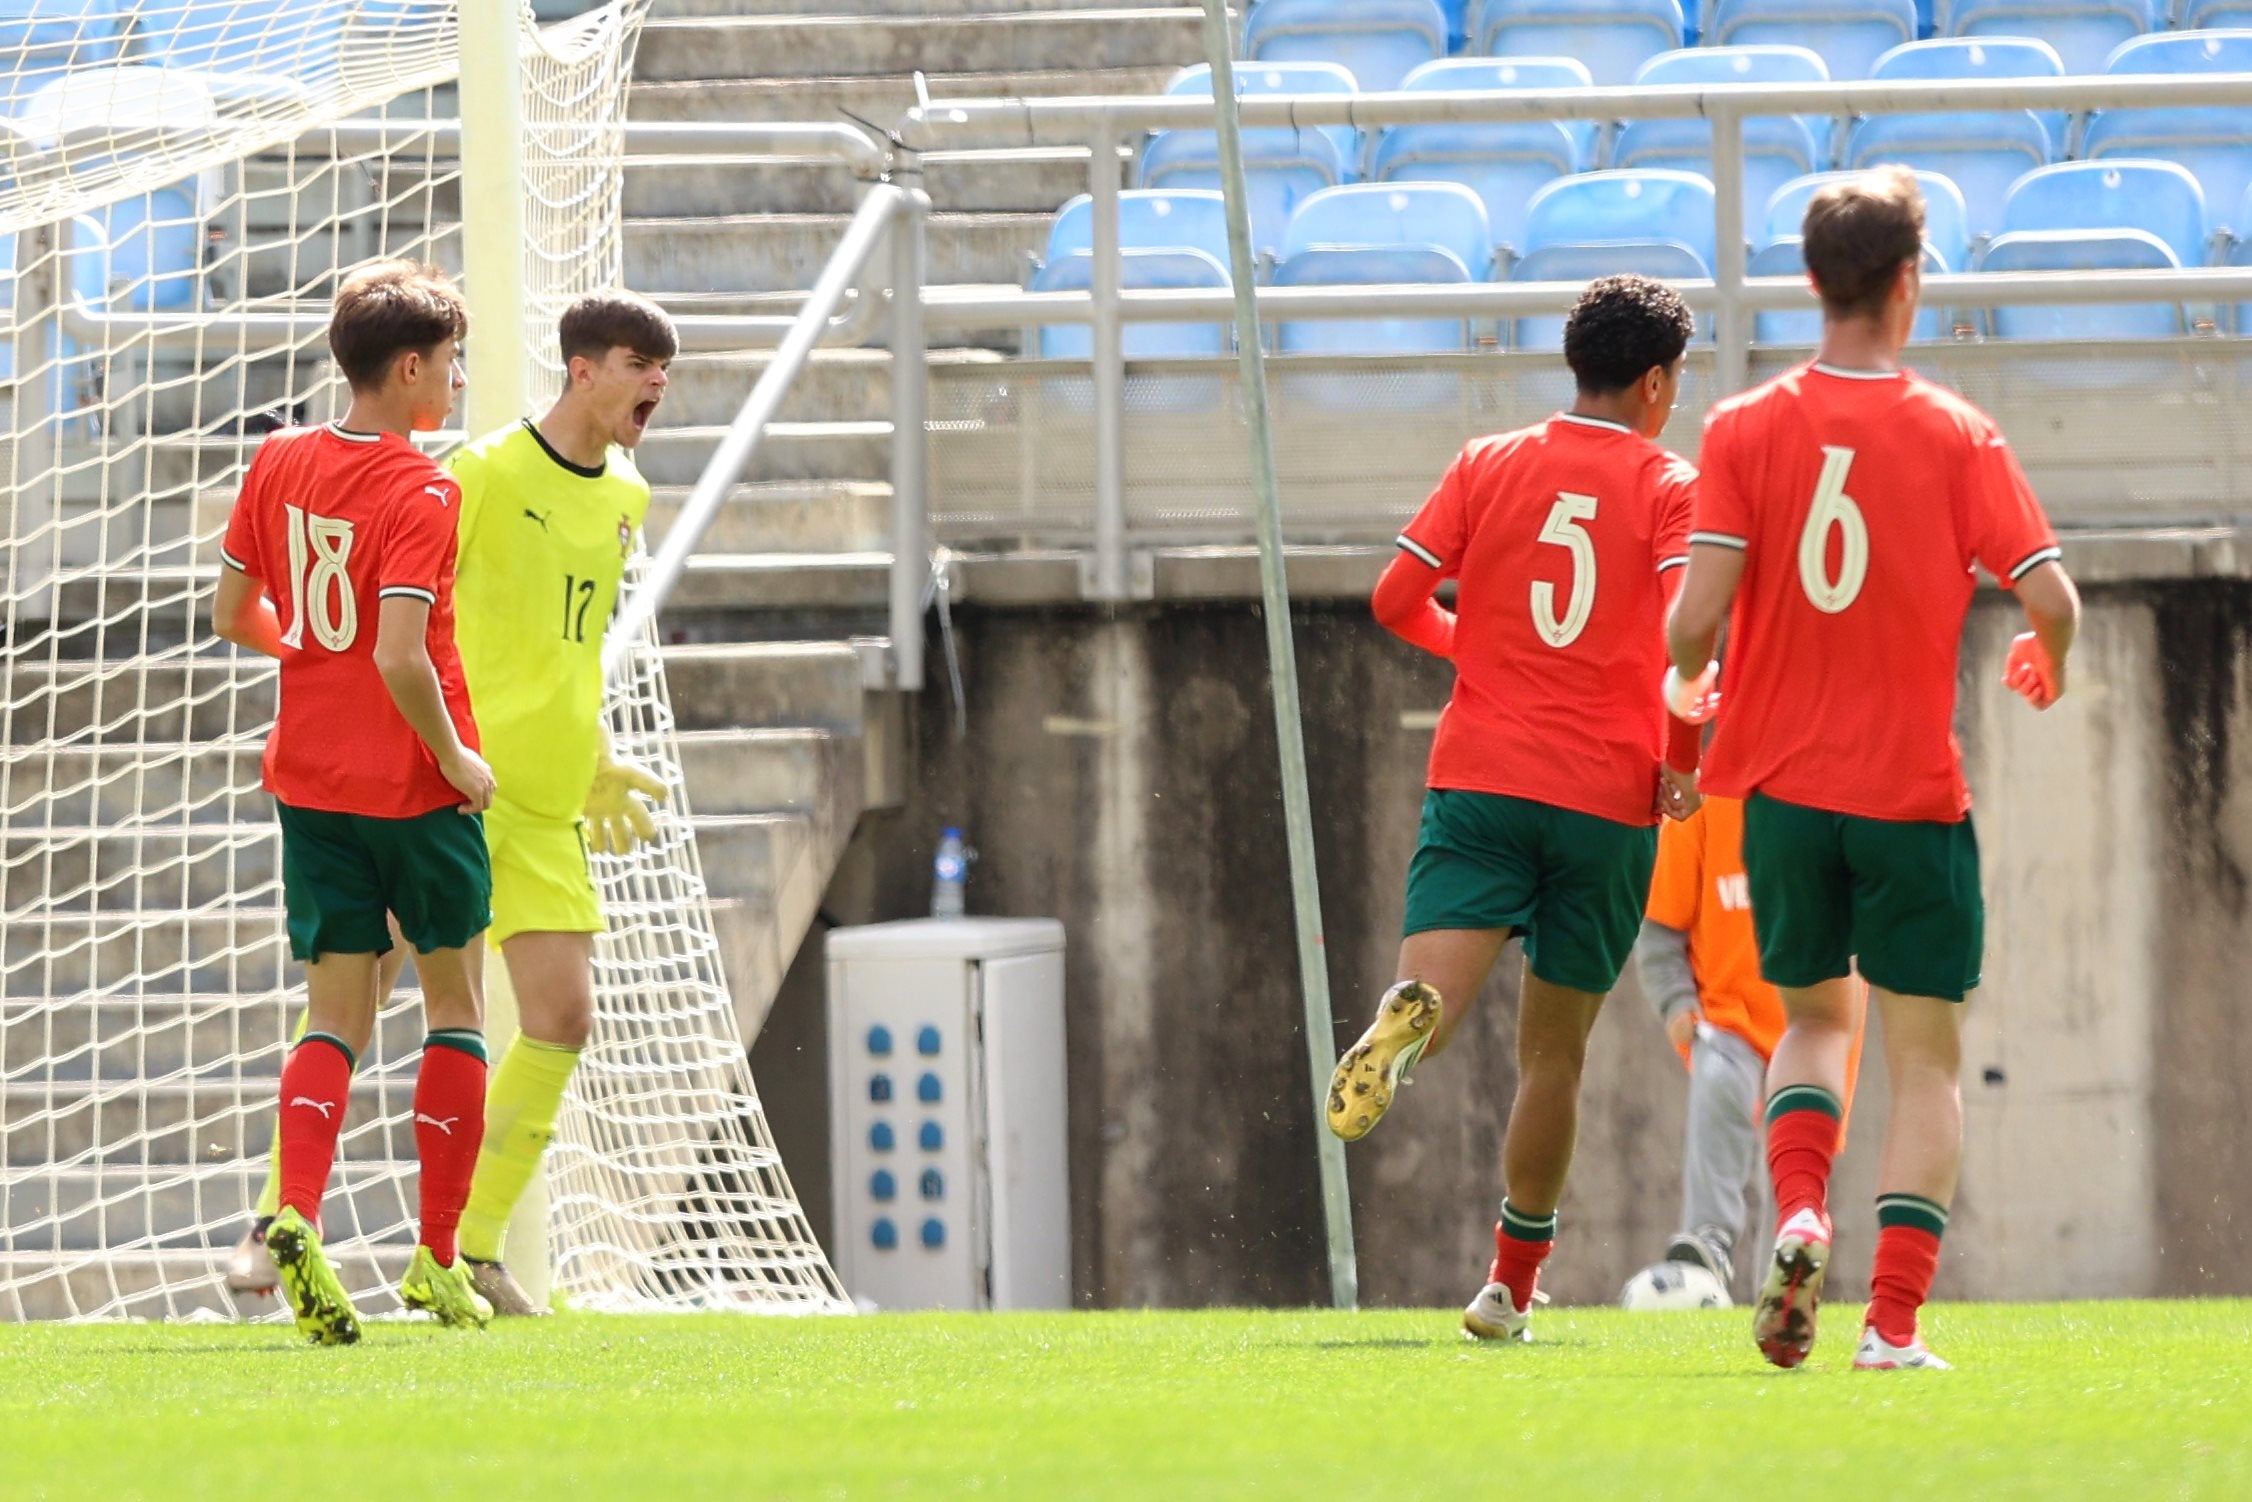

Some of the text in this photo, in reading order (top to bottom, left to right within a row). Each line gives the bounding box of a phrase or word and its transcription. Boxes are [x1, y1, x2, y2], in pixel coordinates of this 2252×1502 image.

[281, 503, 358, 652] 18
[1530, 491, 1598, 648] 5
[1799, 445, 1869, 614] 6
